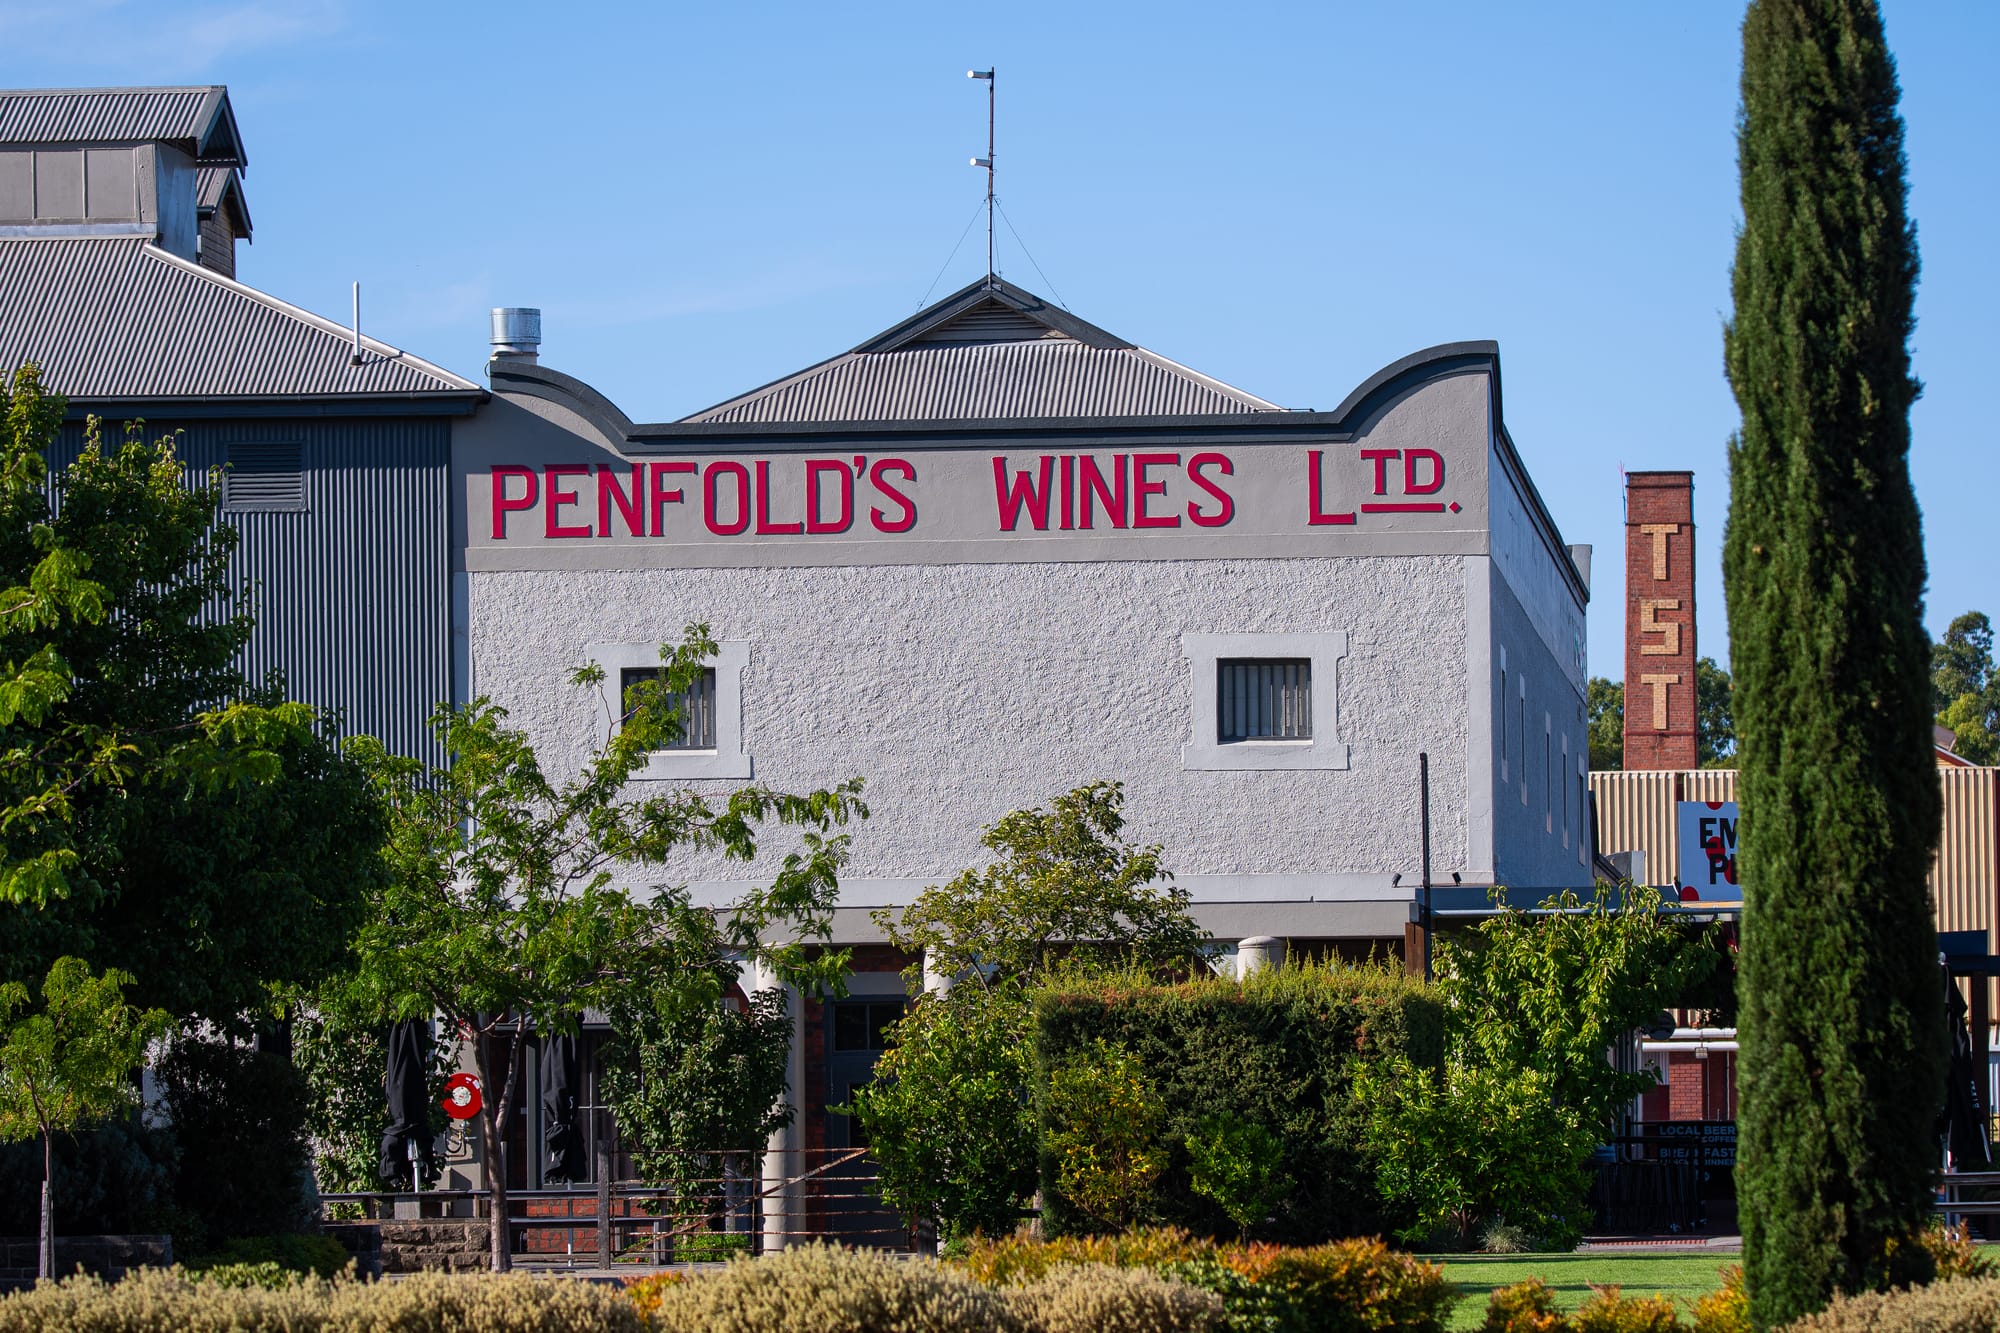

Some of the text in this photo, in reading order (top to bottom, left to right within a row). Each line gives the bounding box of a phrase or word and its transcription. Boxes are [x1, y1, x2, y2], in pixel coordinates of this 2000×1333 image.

[490, 455, 917, 539] PENFOLD'S
[992, 452, 1234, 531] WINES
[1659, 1125, 1736, 1136] LOCAL BEER
